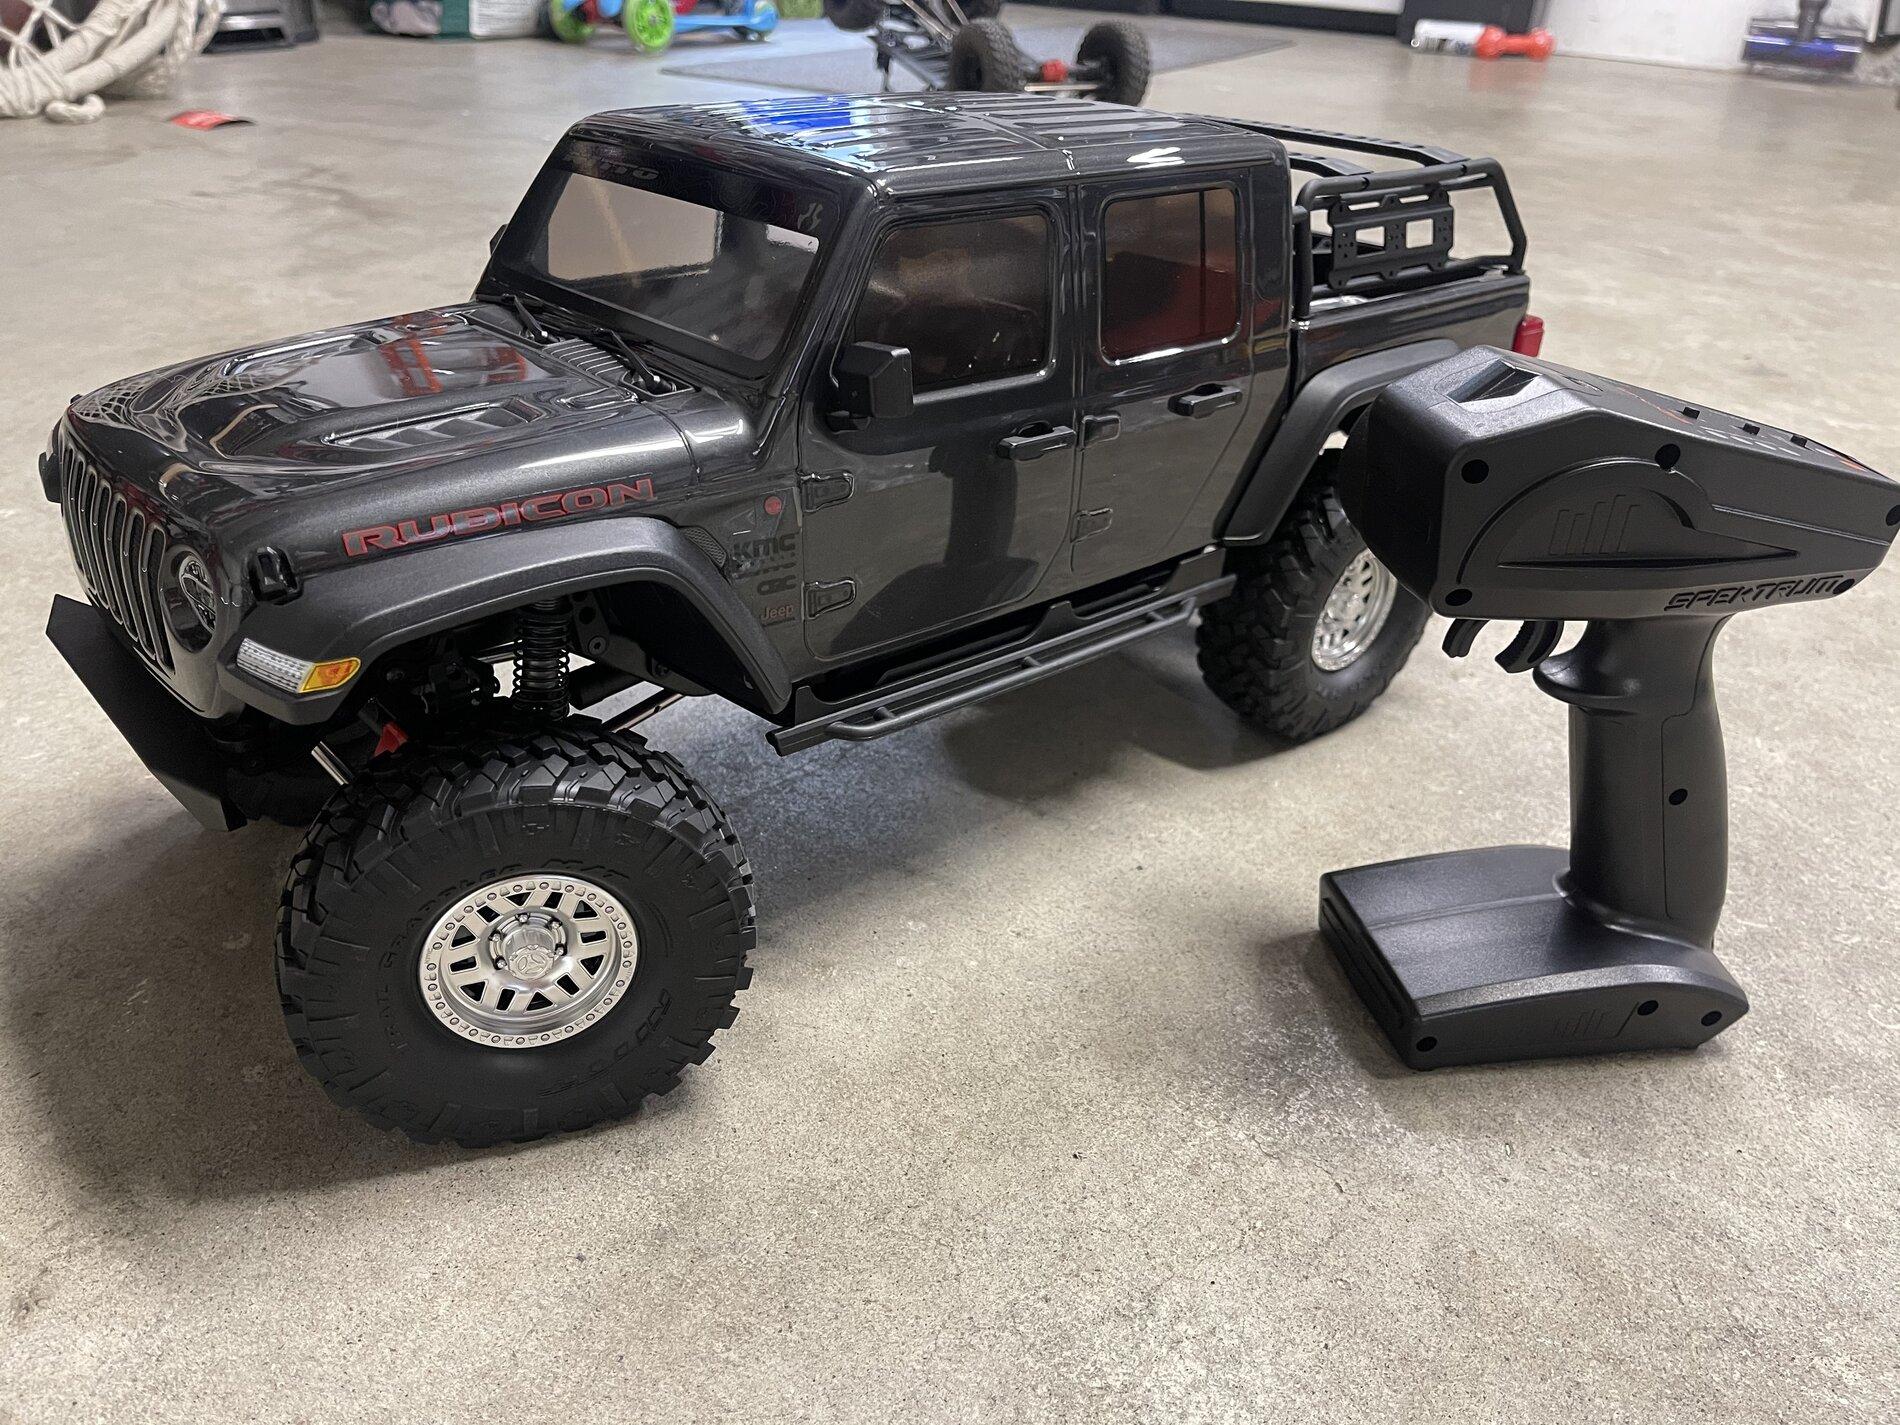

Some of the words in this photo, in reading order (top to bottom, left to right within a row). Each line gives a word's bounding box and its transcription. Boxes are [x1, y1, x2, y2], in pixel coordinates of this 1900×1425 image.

[342, 478, 657, 557] RUBICON
[733, 532, 798, 559] KMC
[1663, 575, 1844, 611] SPEKTRUM
[761, 604, 795, 620] Jeep
